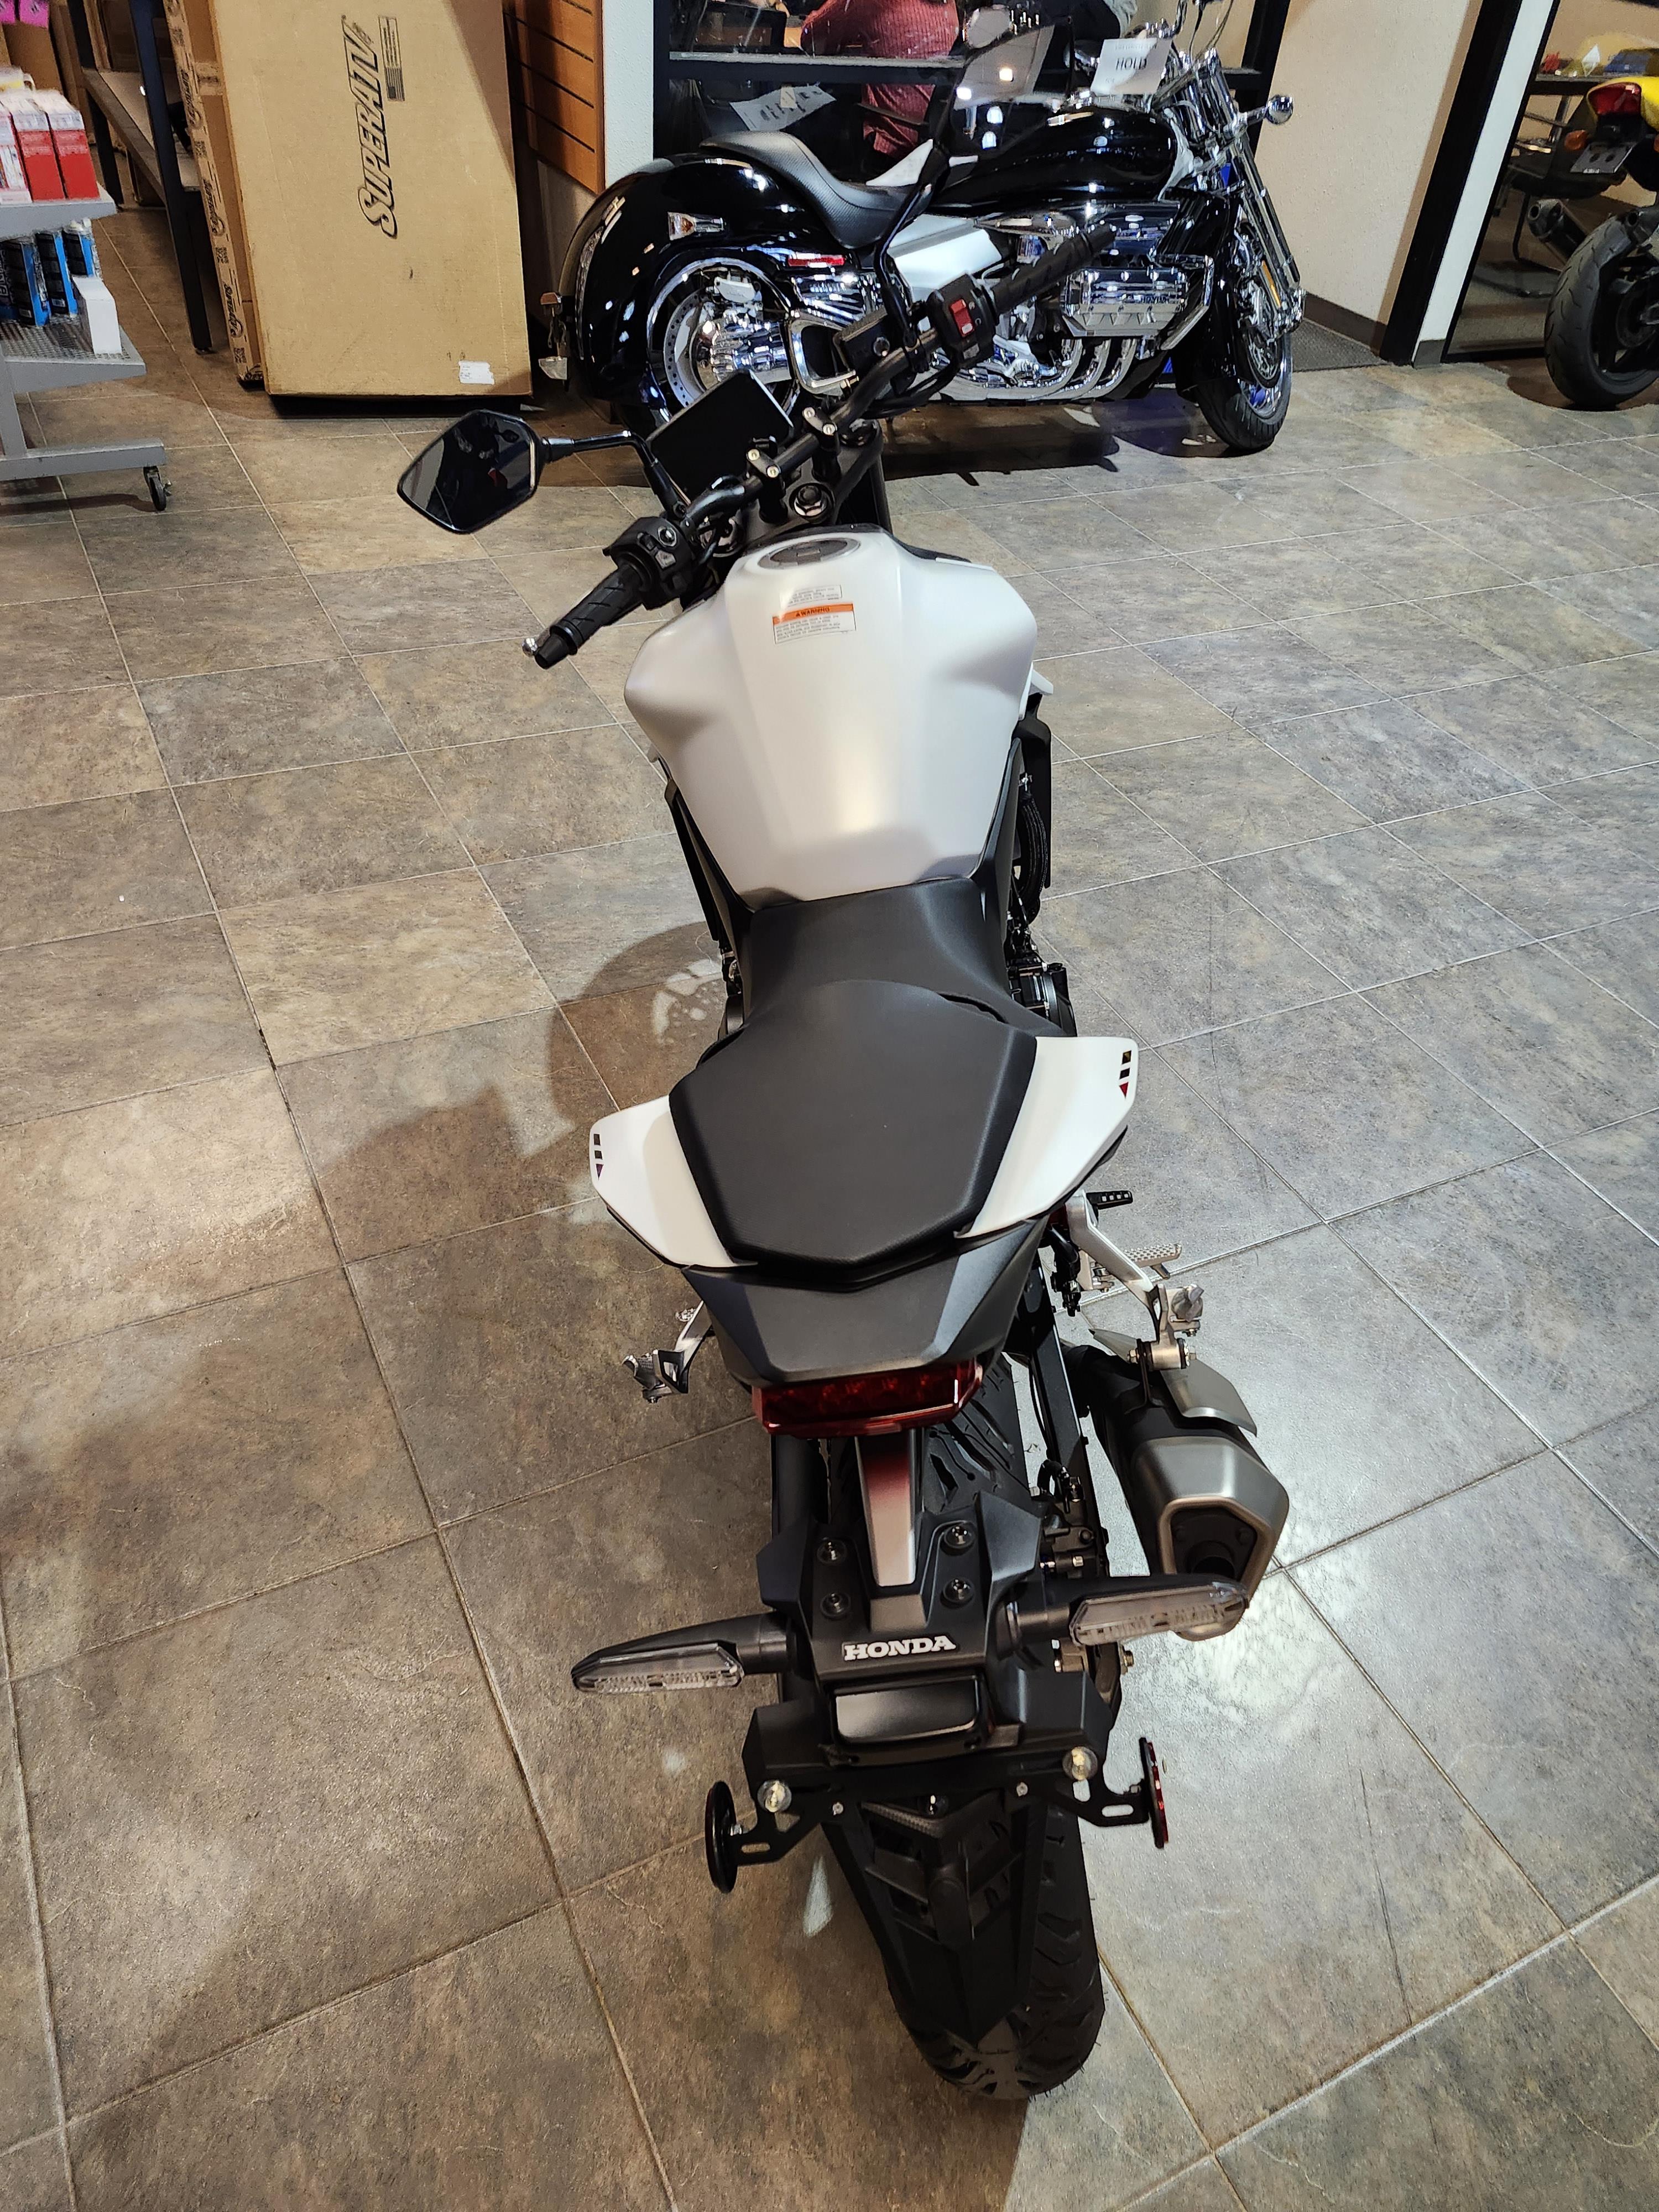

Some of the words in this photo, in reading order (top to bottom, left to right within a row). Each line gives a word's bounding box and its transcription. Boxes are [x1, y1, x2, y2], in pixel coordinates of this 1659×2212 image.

[1116, 57, 1147, 70] HOLD
[342, 17, 398, 239] SUPERATV
[800, 607, 830, 615] WARNING
[844, 1635, 957, 1661] HONDA
